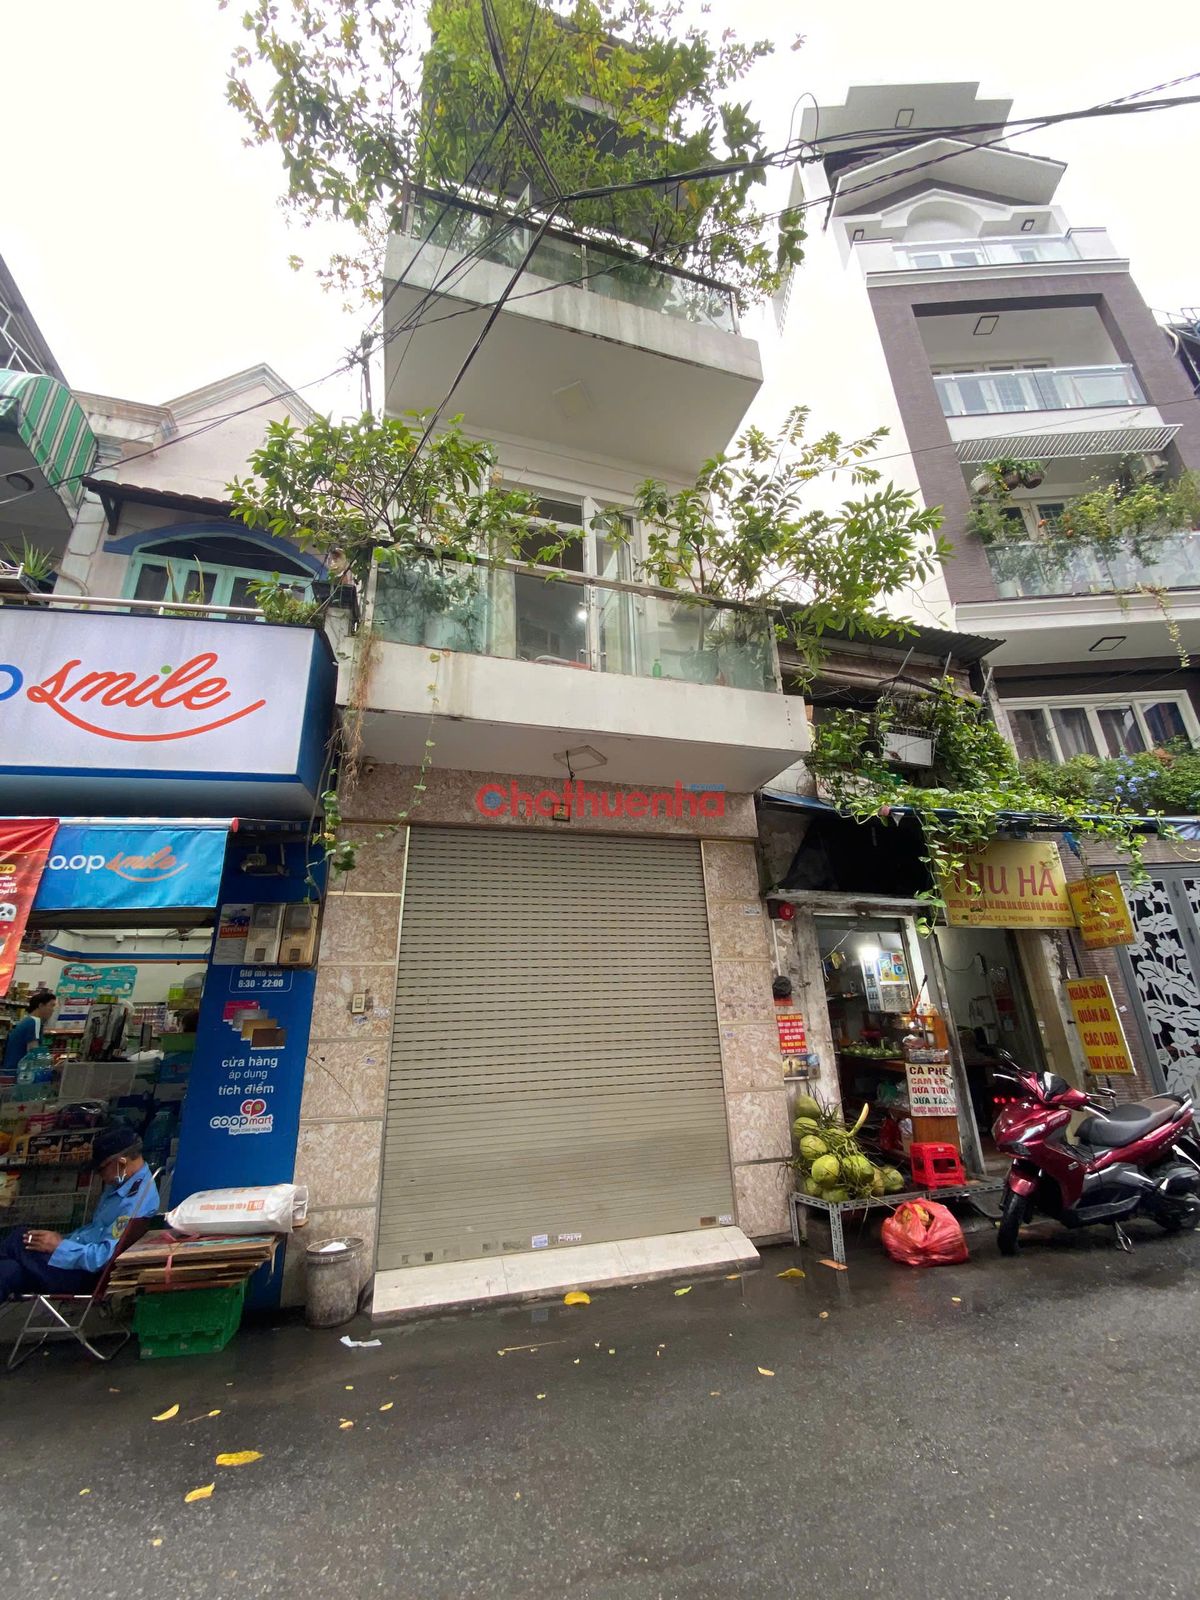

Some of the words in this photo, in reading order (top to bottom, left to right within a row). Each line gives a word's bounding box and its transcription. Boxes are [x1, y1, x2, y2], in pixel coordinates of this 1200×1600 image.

[26, 652, 252, 731] smile
[44, 854, 105, 874] o.op
[105, 845, 184, 878] smile
[1017, 861, 1058, 897] HÀ
[238, 979, 256, 988] 6:30
[262, 979, 284, 988] 22:00
[221, 1056, 245, 1068] cửa
[248, 1056, 279, 1068] hàng
[228, 1070, 242, 1080] áp
[909, 1065, 925, 1075] CÀ
[218, 1084, 241, 1095] tích
[244, 1081, 275, 1095] điểm
